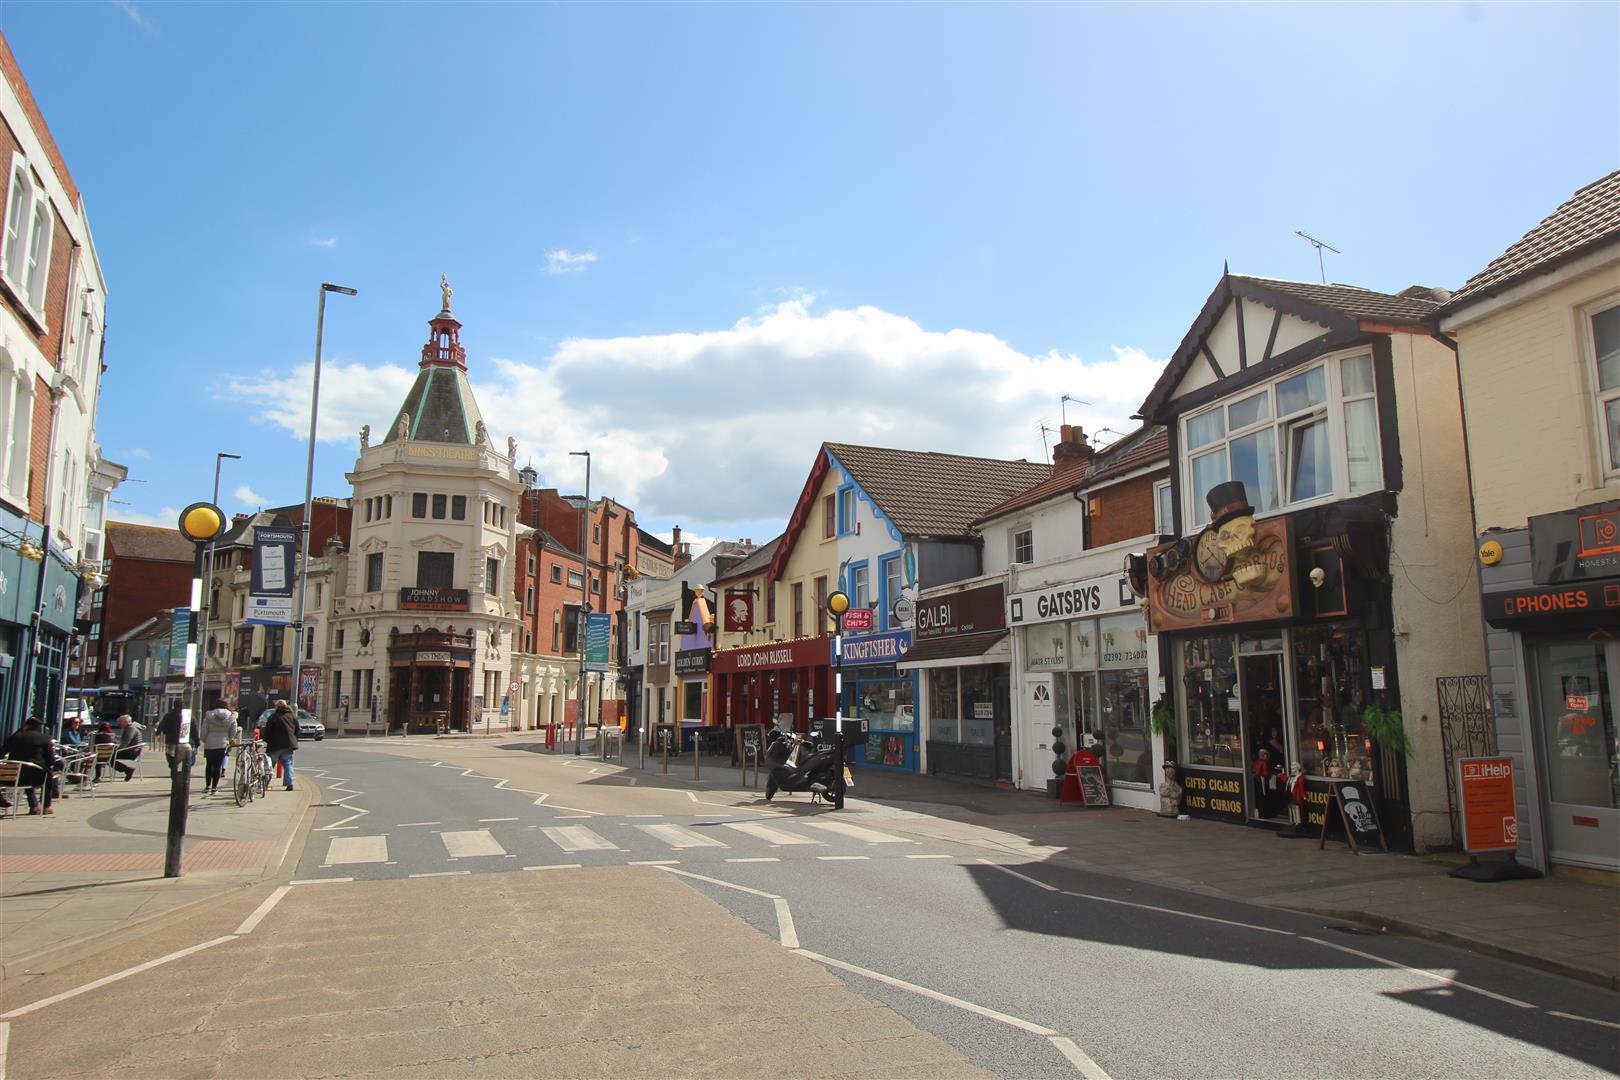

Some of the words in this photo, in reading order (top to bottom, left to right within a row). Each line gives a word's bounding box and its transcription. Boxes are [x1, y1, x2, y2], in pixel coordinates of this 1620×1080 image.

[1480, 549, 1495, 558] Yale
[1579, 558, 1609, 568] HONEST
[406, 595, 461, 603] ROADSHOW
[1037, 585, 1100, 617] GATSBYS
[1167, 586, 1197, 611] HEAD
[1516, 590, 1589, 613] PHONES
[254, 608, 286, 616] Portsmouth
[918, 603, 951, 628] GALBI
[844, 638, 897, 660] KINGFISHER
[737, 654, 752, 667] LORD
[752, 651, 769, 666] JOHN
[769, 649, 793, 664] RUSSELL
[1044, 657, 1064, 665] STYLIST
[1104, 652, 1122, 662] 02392
[1481, 763, 1510, 778] iHelp
[1185, 776, 1206, 789] GIFTS
[1209, 779, 1240, 793] CIGARS
[1186, 796, 1206, 809] HATS
[1210, 798, 1242, 813] CURIOS
